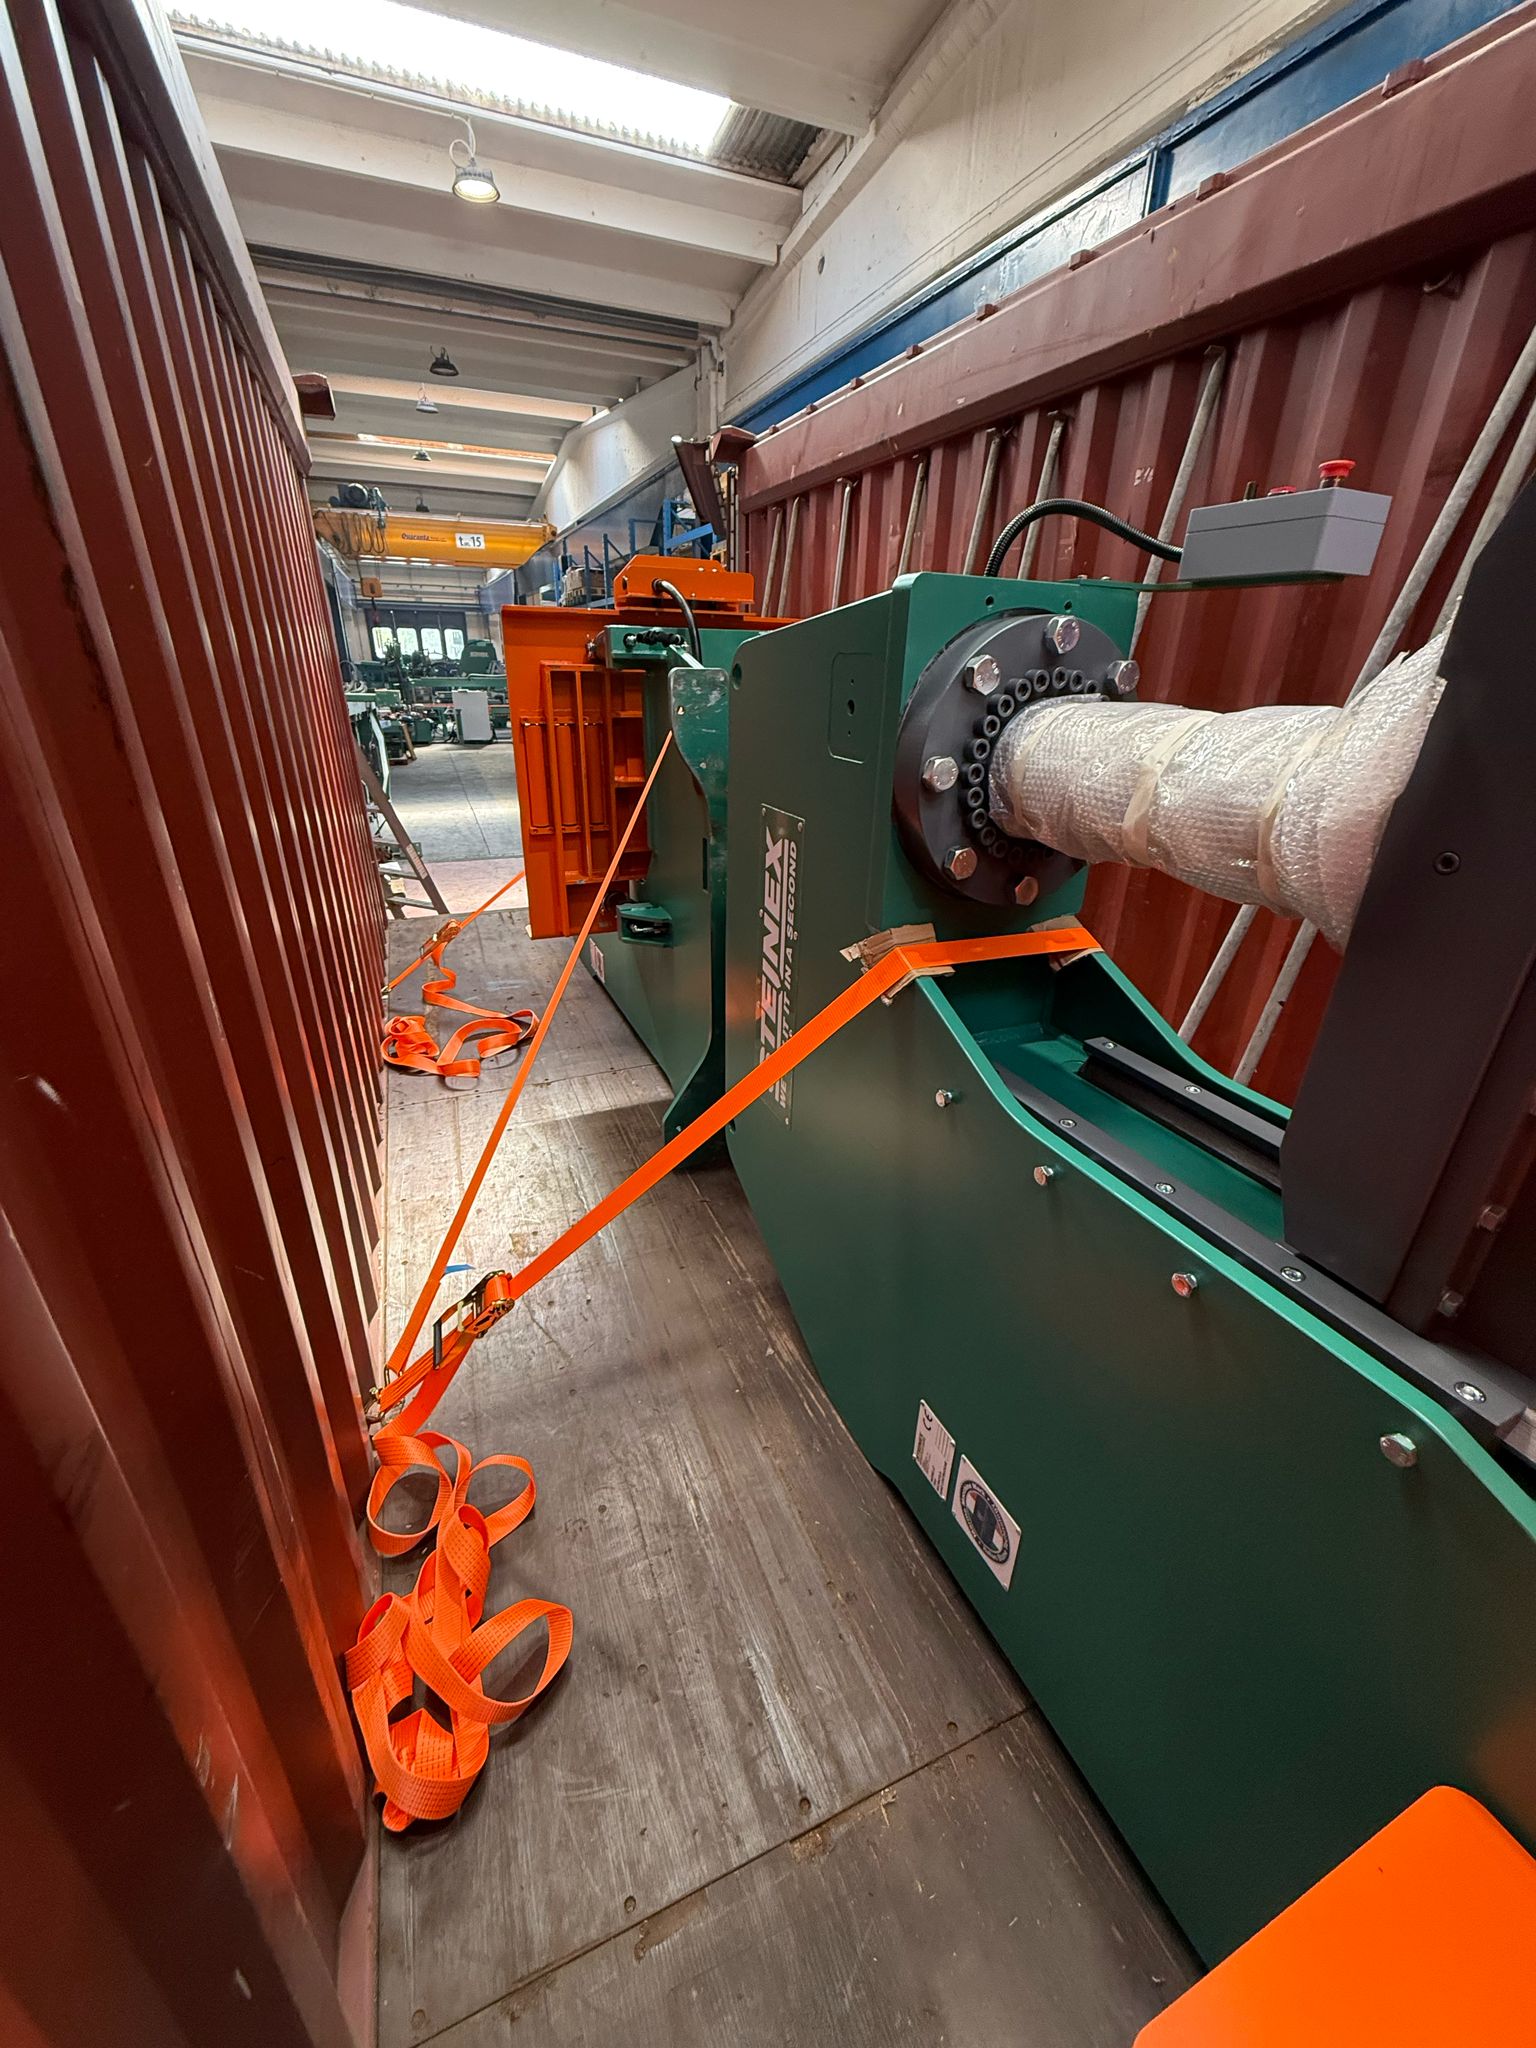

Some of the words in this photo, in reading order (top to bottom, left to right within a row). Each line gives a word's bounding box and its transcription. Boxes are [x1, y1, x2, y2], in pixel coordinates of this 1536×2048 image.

[470, 536, 482, 548] 15
[786, 840, 798, 940] SECOND
[785, 947, 793, 963] A
[784, 966, 793, 991] IN
[783, 990, 792, 1015] IT
[779, 1079, 788, 1108] WE
